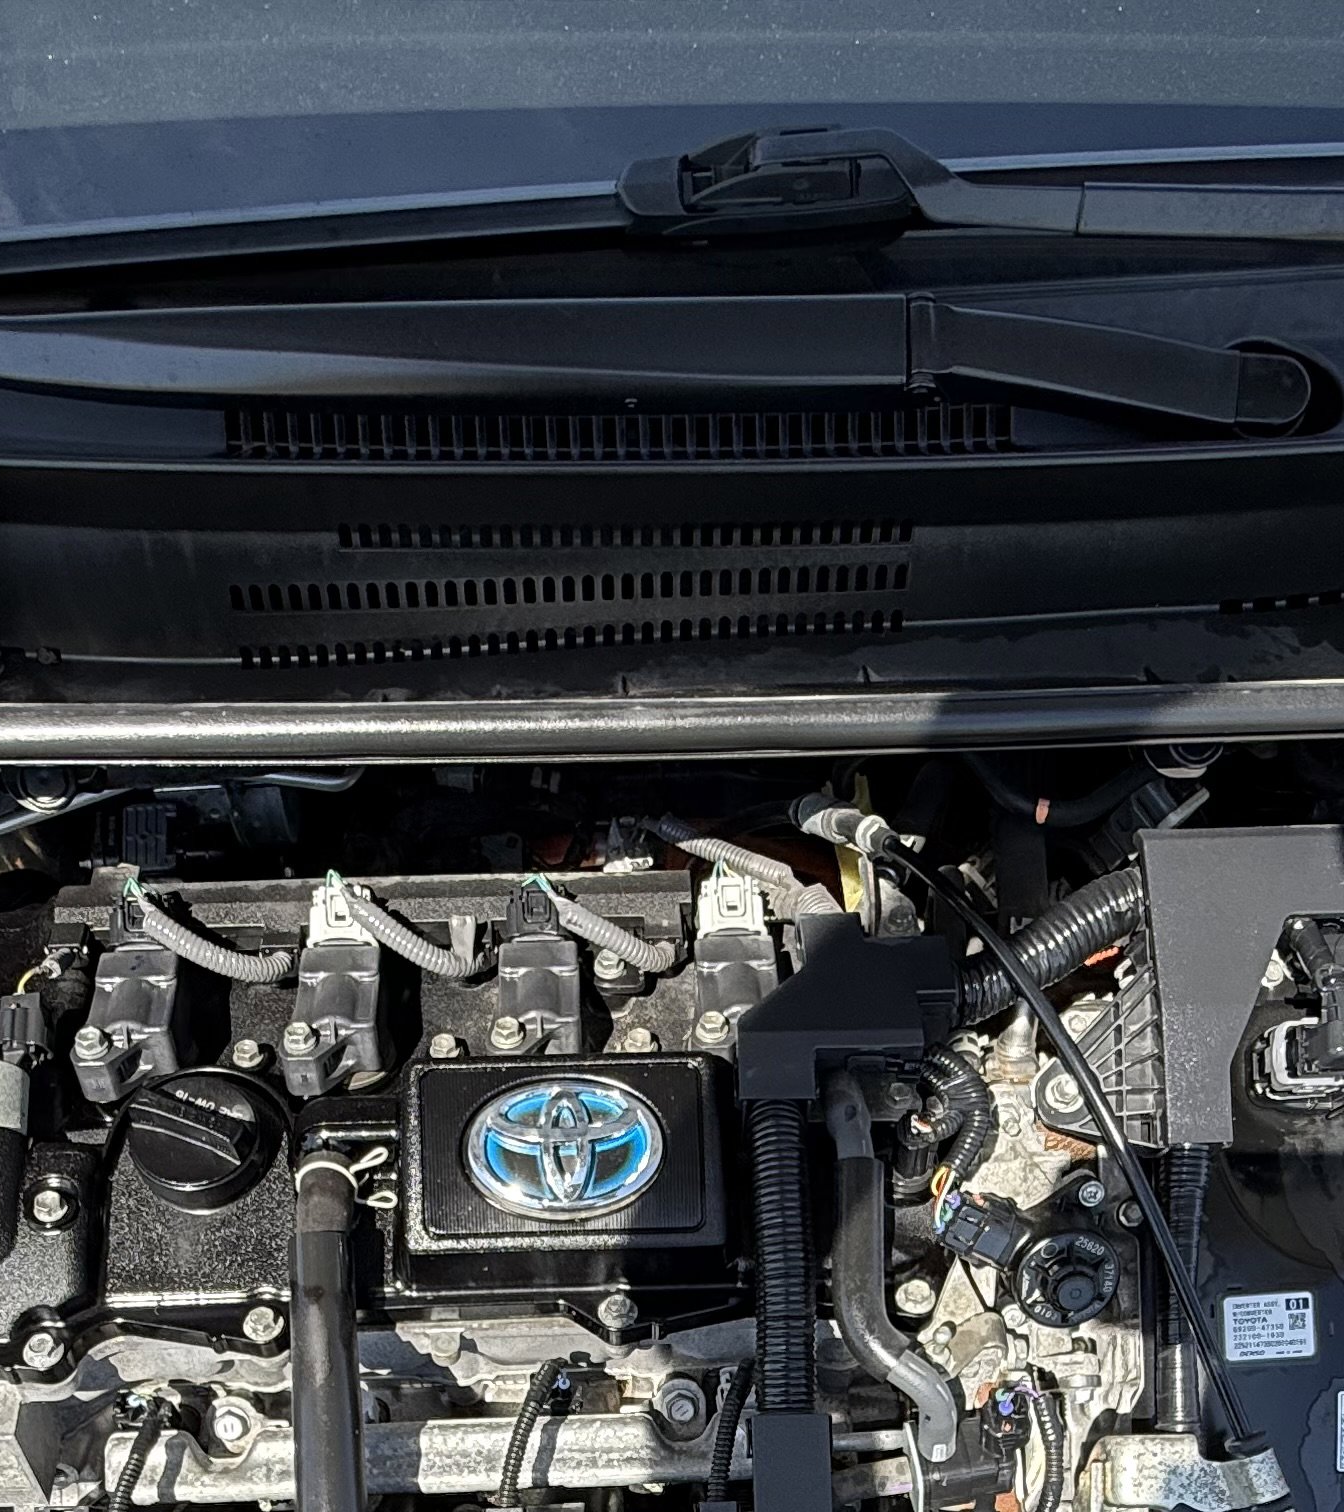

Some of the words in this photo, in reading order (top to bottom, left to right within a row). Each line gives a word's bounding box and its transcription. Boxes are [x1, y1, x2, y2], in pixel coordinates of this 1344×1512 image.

[1102, 1263, 1115, 1293] 37140
[1289, 1298, 1304, 1310] 01
[1232, 1317, 1268, 1326] TOYOTA
